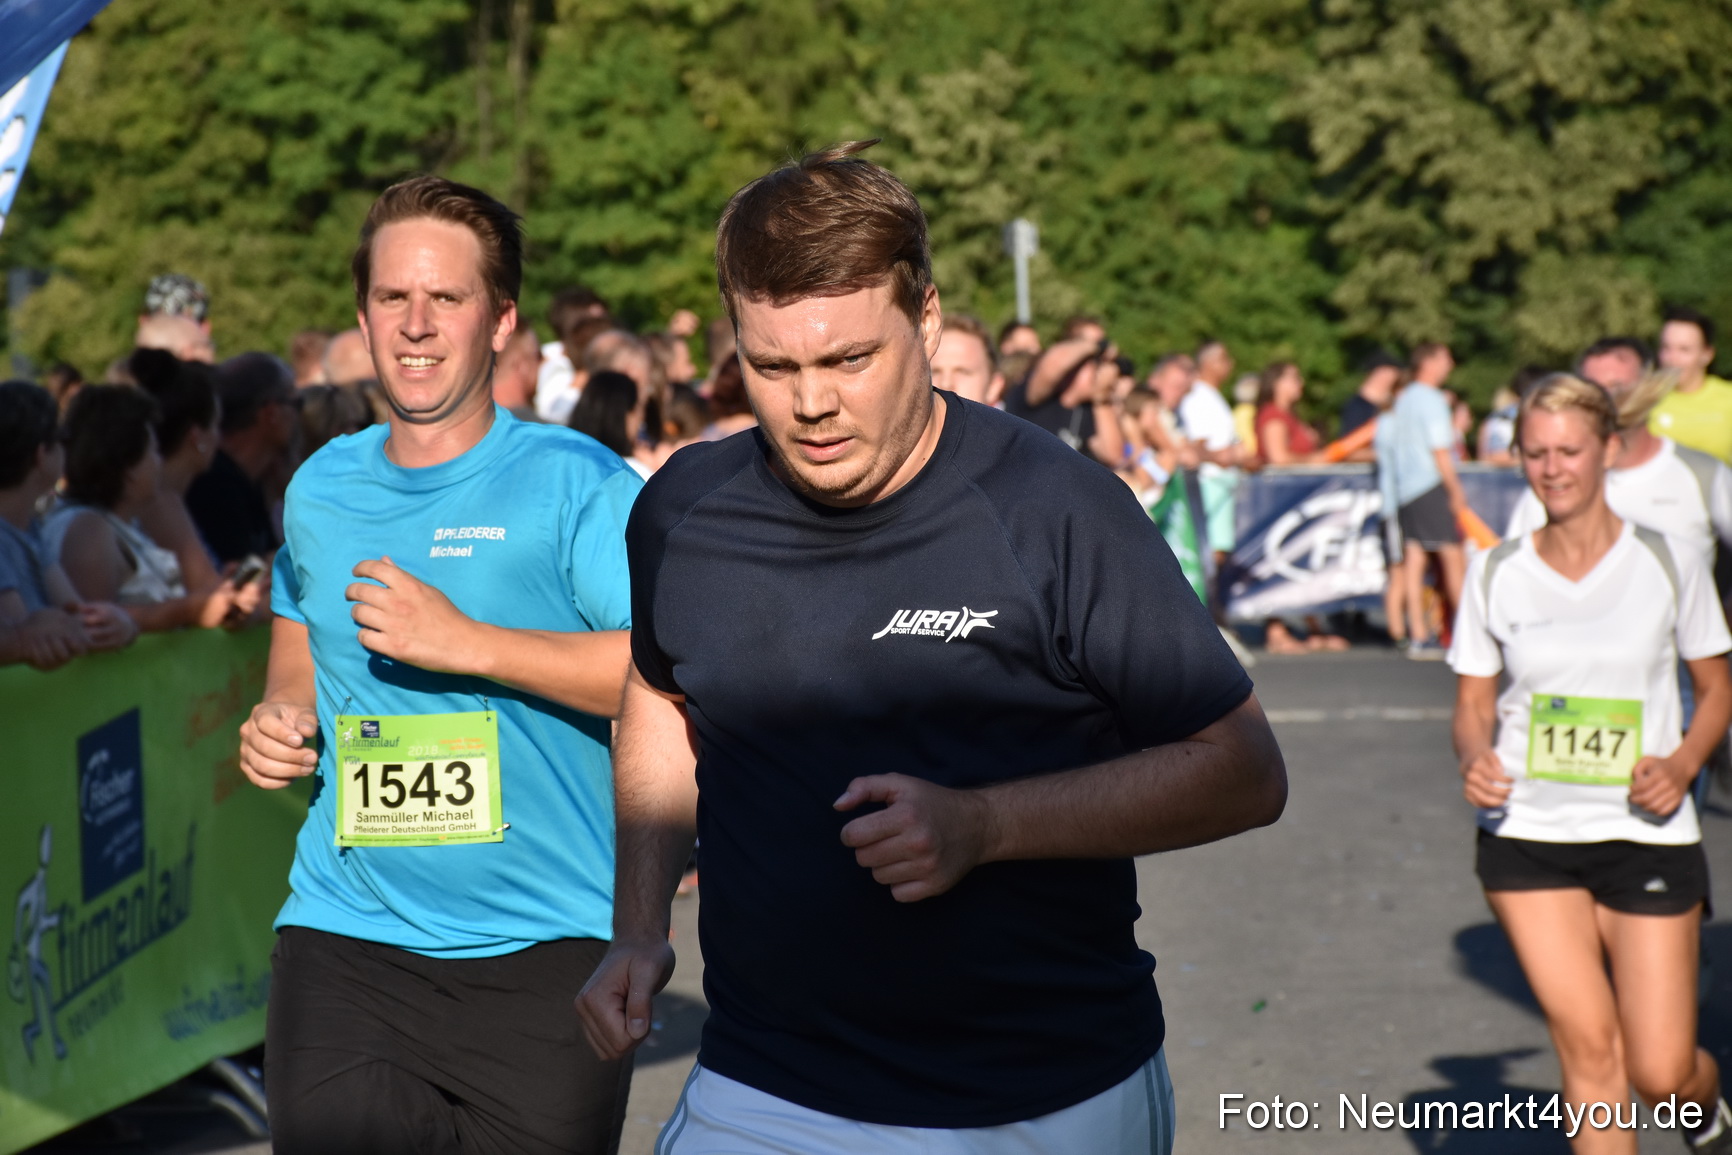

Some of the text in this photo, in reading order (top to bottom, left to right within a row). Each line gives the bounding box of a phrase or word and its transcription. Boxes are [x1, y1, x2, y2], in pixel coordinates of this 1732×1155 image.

[429, 545, 473, 558] Michael
[872, 609, 961, 640] JURA
[890, 627, 946, 637] SPORT SERVICE
[352, 736, 401, 748] firmenlauf
[1543, 726, 1628, 758] 1147
[407, 744, 439, 757] 2018
[353, 760, 475, 808] 1543
[356, 809, 474, 824] Sammüller Michael
[353, 822, 477, 834] Pfleiderer Deutschland GmbH
